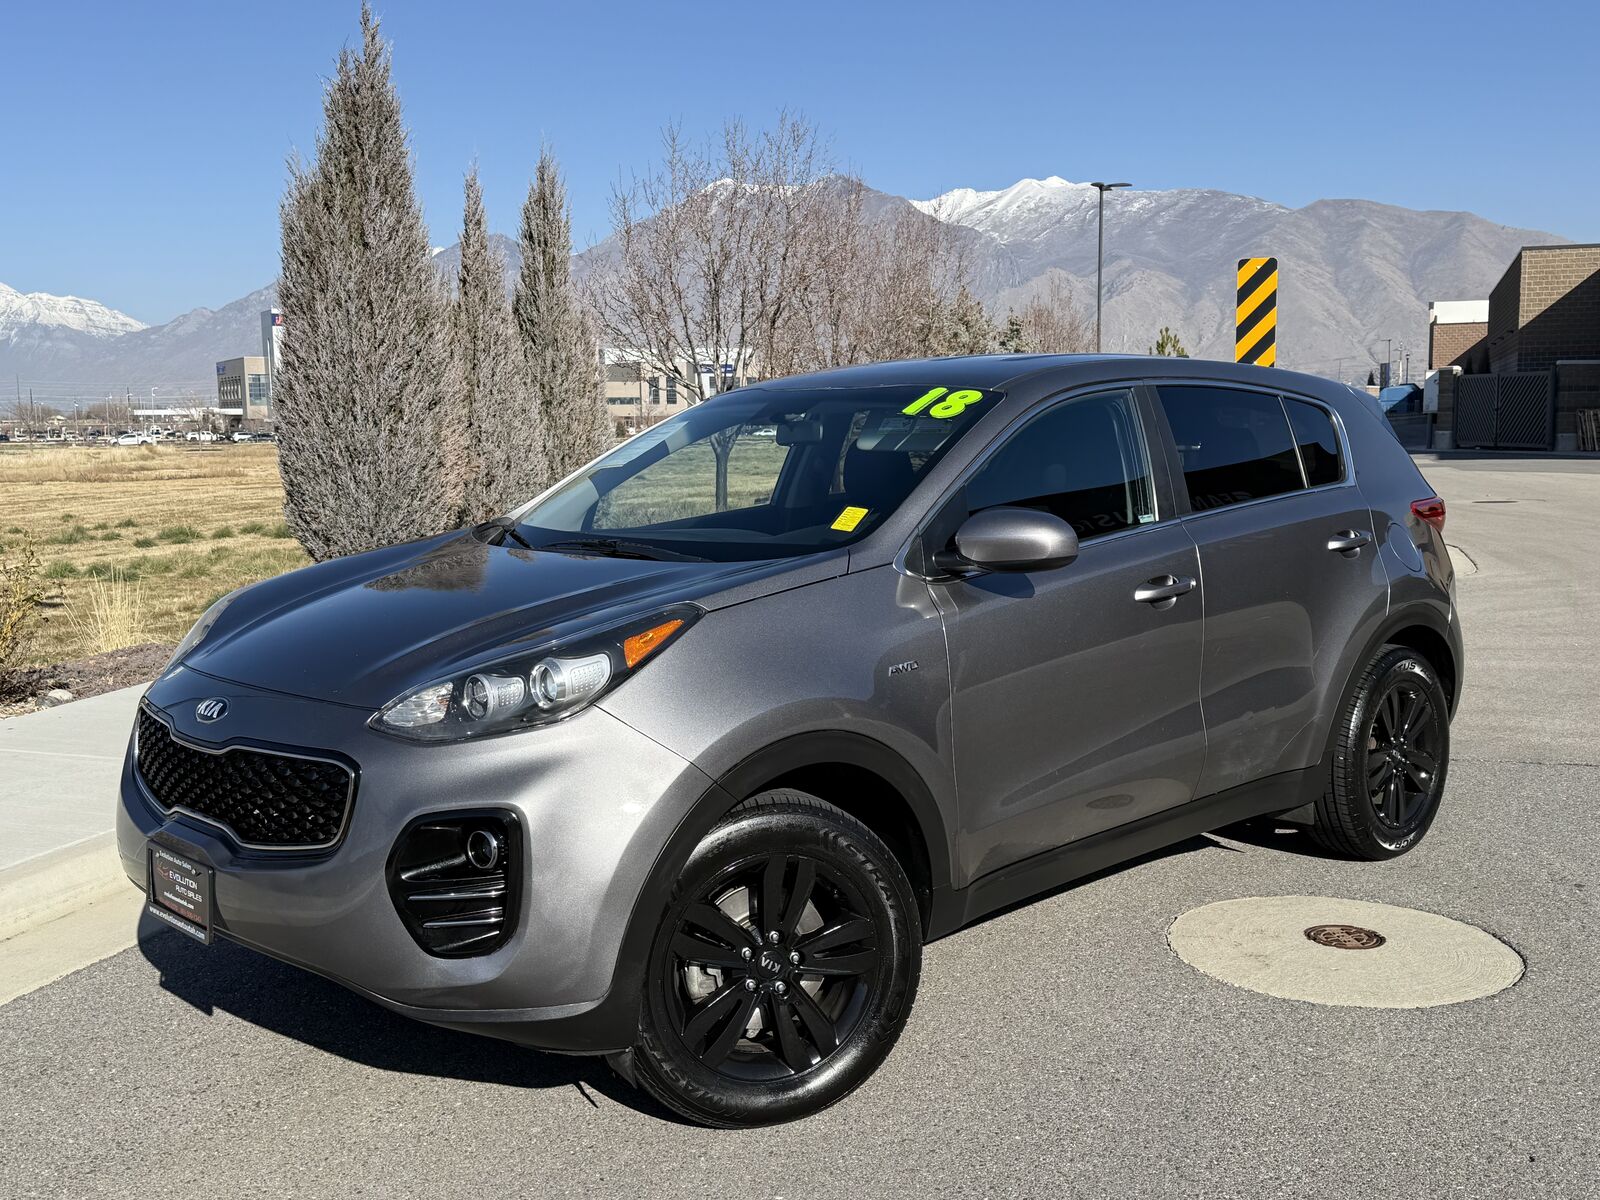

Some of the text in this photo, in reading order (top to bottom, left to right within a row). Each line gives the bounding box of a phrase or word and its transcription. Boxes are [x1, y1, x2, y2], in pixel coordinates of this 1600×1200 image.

[901, 387, 983, 419] 18
[888, 660, 919, 677] AWD
[197, 699, 224, 719] KIA
[169, 870, 198, 890] EVOLUTION
[175, 884, 203, 903] AUTO SALES
[761, 956, 781, 974] KIA
